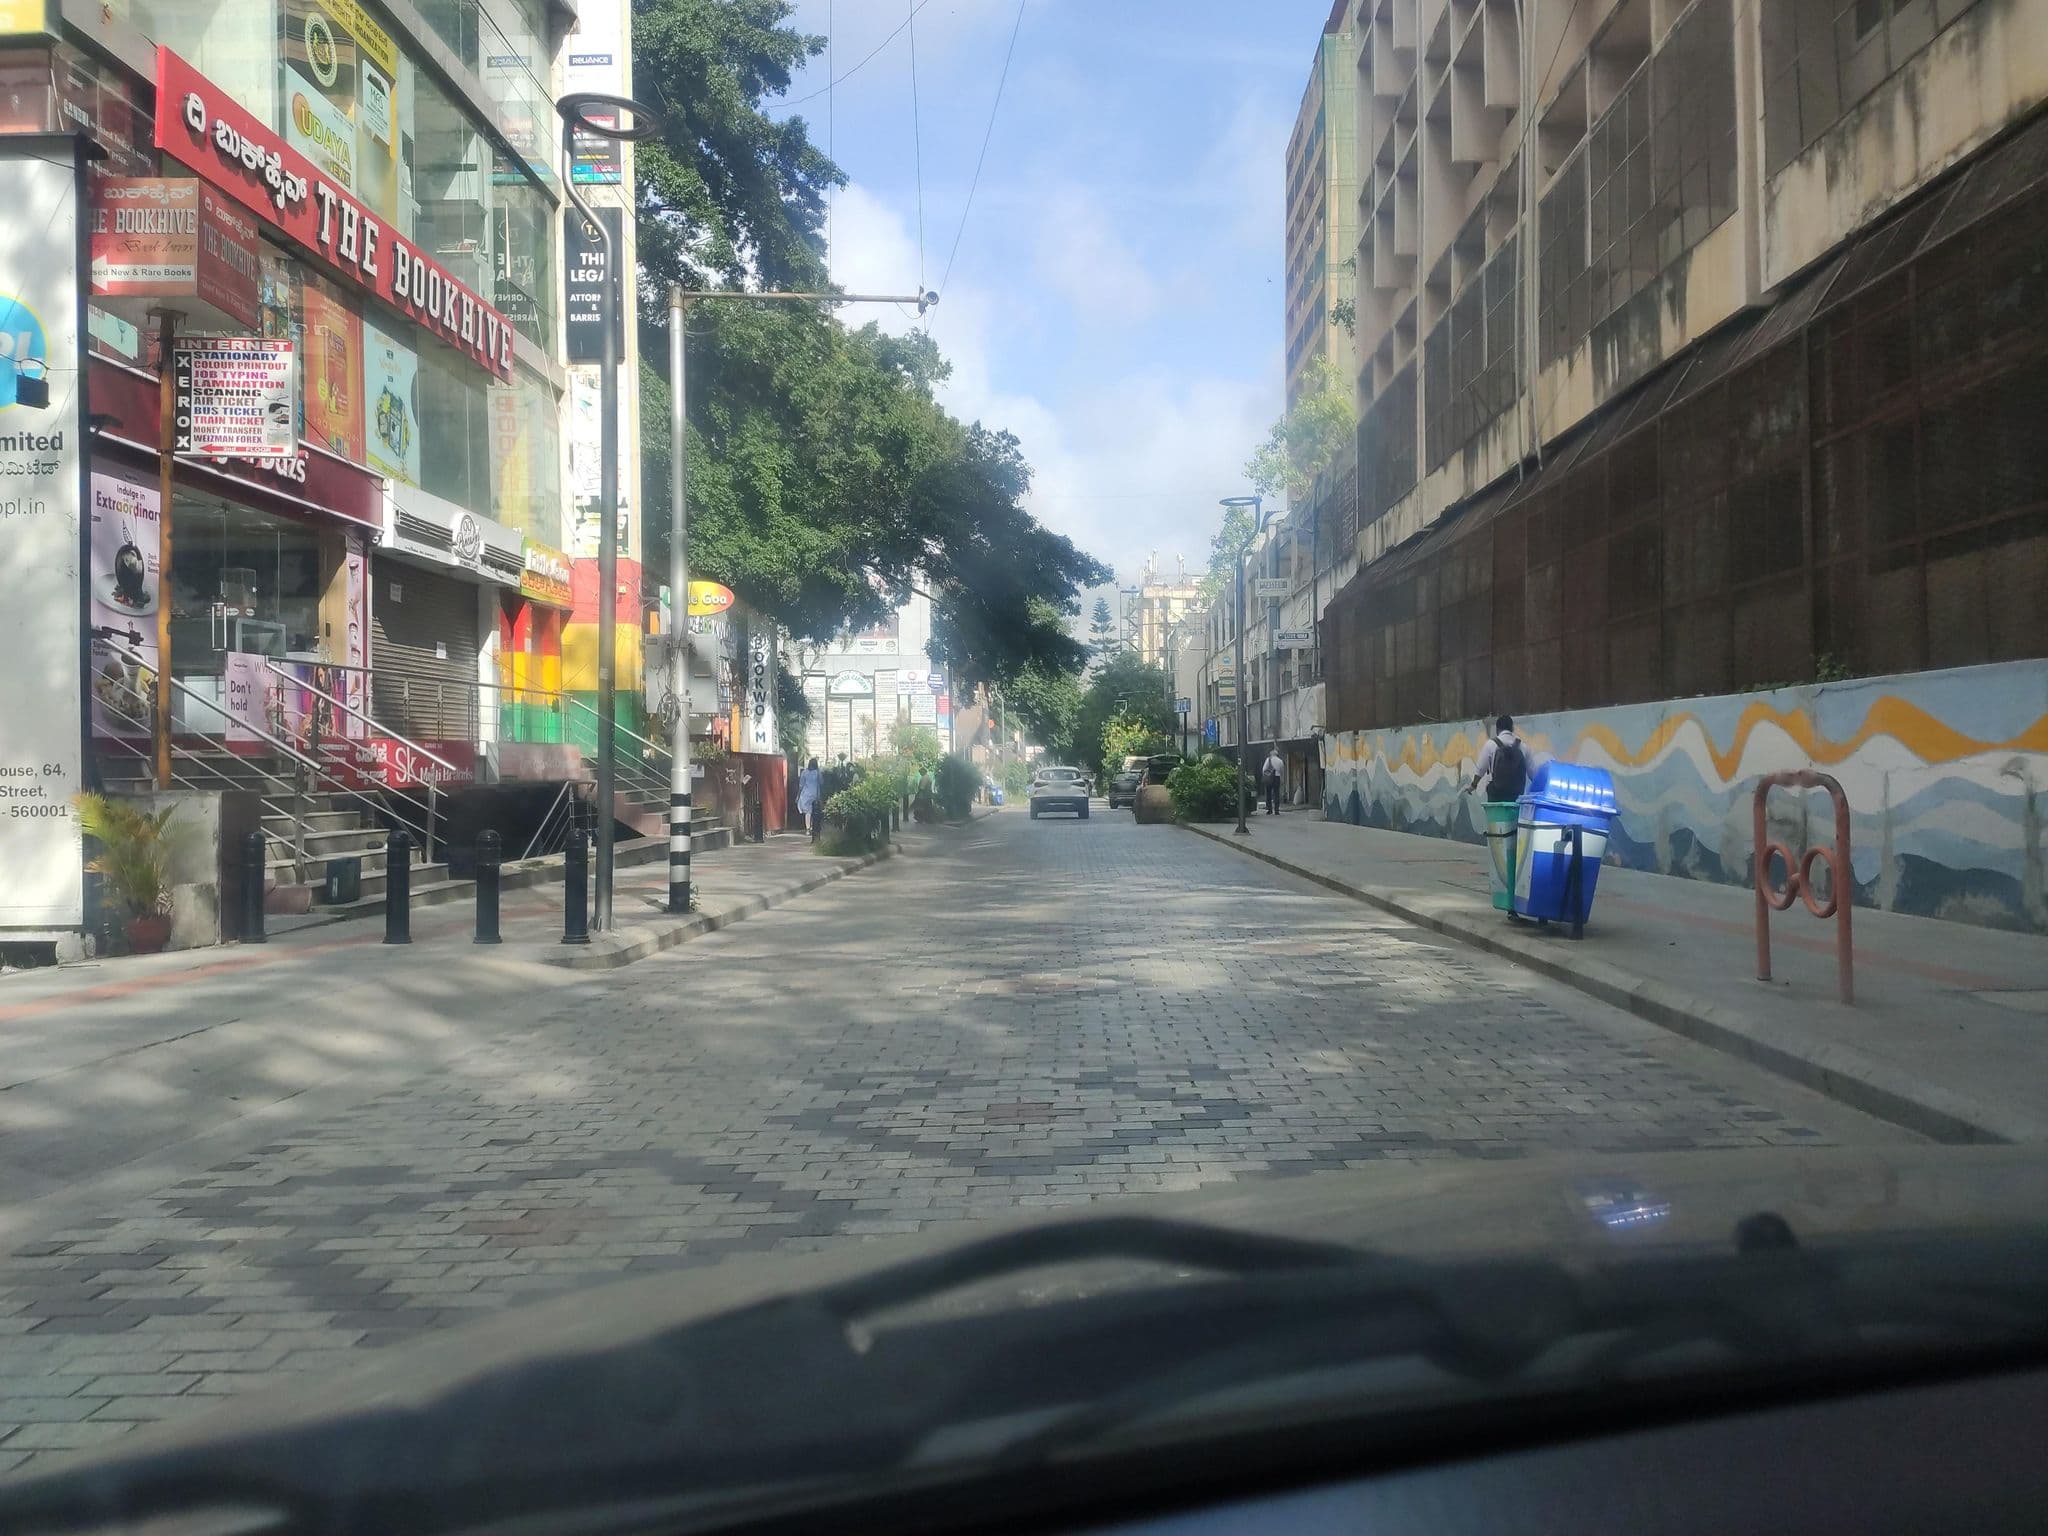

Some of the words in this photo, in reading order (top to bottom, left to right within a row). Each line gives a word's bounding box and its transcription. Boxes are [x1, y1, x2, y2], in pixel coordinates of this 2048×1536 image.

[301, 105, 352, 170] UDAYA
[115, 208, 196, 234] BOOKHIVE
[203, 222, 218, 258] THE
[221, 234, 256, 282] BOOKHIVE
[111, 269, 130, 277] New
[318, 181, 379, 277] THE
[395, 241, 511, 371] BOOKHIVE
[181, 340, 290, 351] INTERNET
[194, 352, 278, 361] STATIONARY
[194, 361, 234, 369] COLOUR
[236, 362, 287, 370] PRINTOUT
[222, 371, 268, 379] TYPING
[194, 381, 285, 389] LAMINATION
[177, 356, 190, 448] XEROX
[194, 398, 214, 406] AIR
[220, 398, 257, 406] TICKET
[194, 407, 218, 415] BUS
[223, 408, 264, 416] TICKET
[194, 416, 224, 425] TRAIN
[229, 417, 266, 425] TICKET
[194, 426, 220, 434] MONEY
[194, 435, 234, 443] WEIZMAN
[236, 435, 262, 443] FOREX
[117, 484, 139, 500] Indulge
[139, 490, 146, 501] in
[703, 593, 727, 605] Goa
[230, 680, 251, 694] Don't
[230, 698, 248, 711] hold
[0, 767, 38, 779] ouse,
[43, 763, 66, 779] 64,
[0, 785, 48, 799] Street,
[11, 805, 68, 818] 560001
